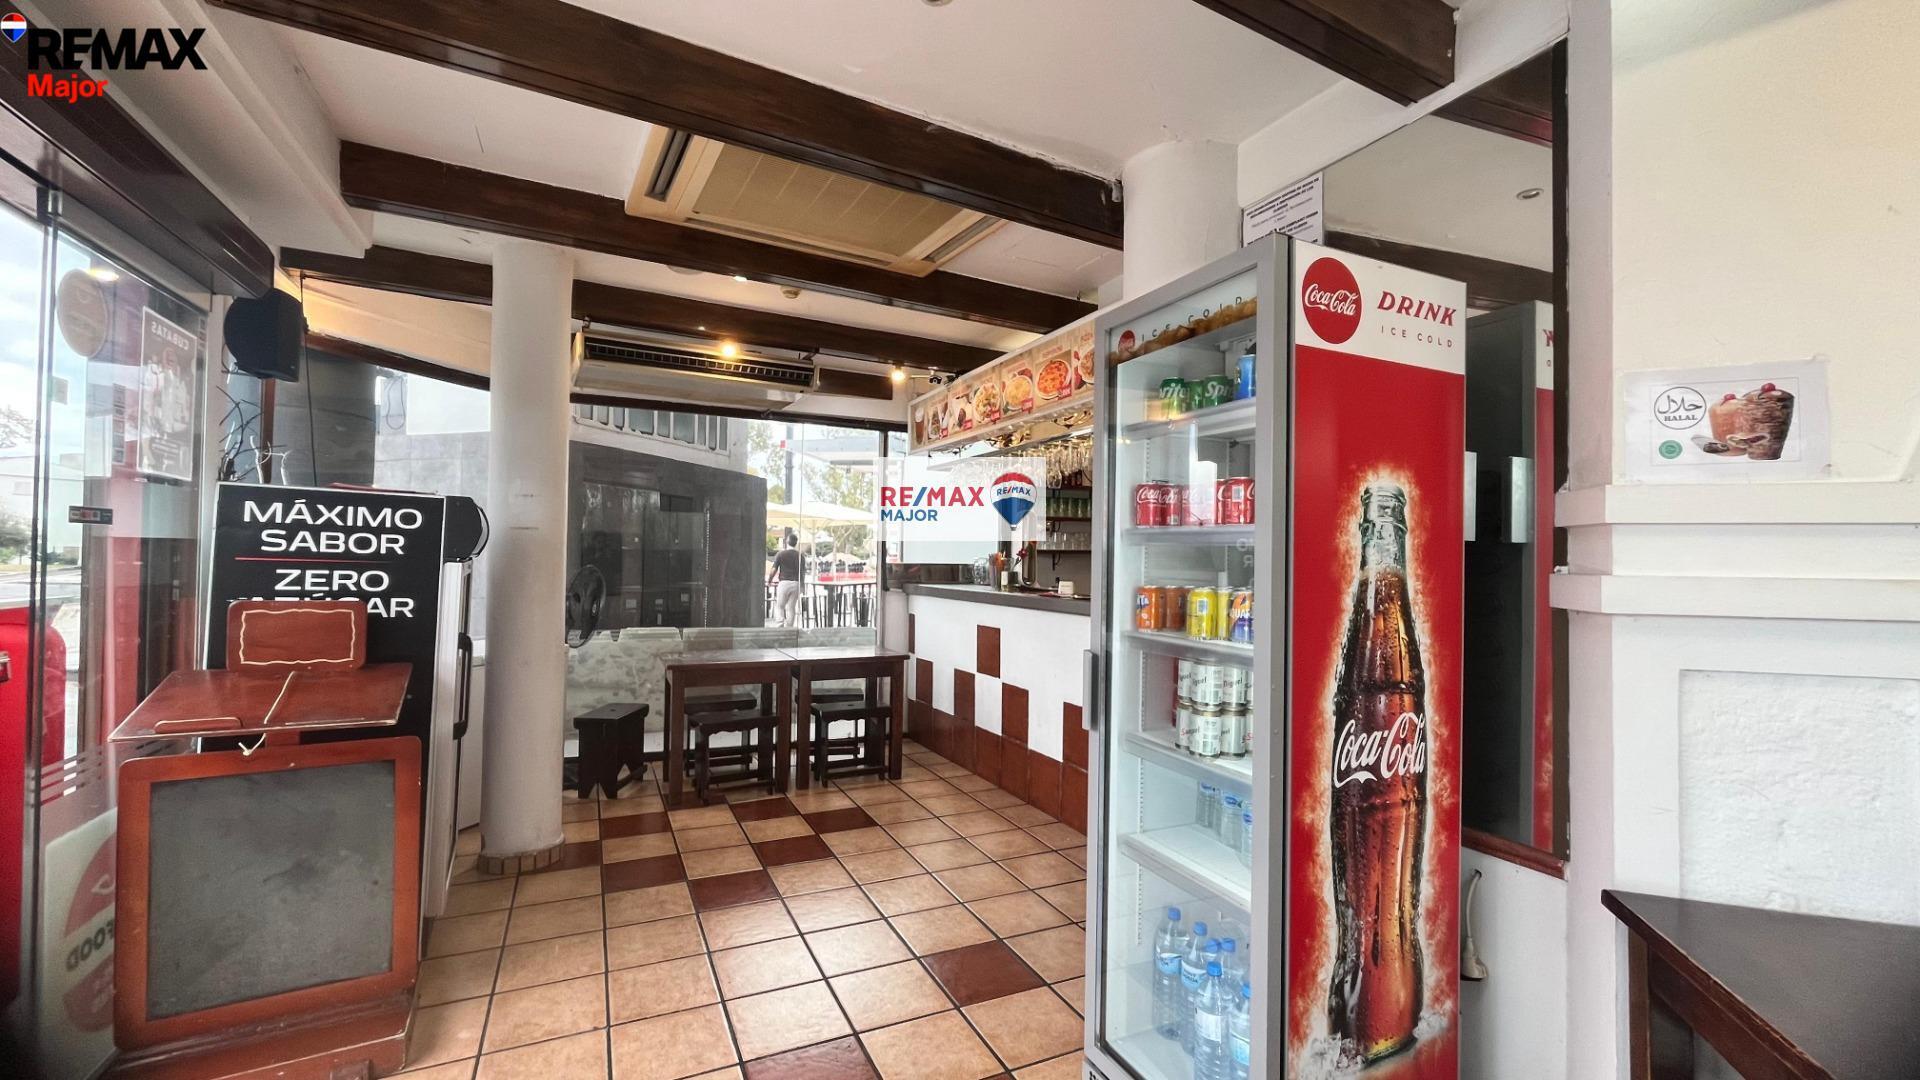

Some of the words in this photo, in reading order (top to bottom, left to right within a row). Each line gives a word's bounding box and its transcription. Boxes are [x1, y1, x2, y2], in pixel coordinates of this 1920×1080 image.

[1304, 282, 1360, 316] Coca-Cola
[1377, 290, 1457, 327] DRINK
[1381, 325, 1407, 338] ICE
[1417, 332, 1453, 348] COLD
[1657, 394, 1703, 414] حلال
[1664, 414, 1698, 422] HALAL
[243, 499, 423, 530] MÁXIMO
[260, 529, 405, 555] SABOR
[274, 568, 390, 592] ZERO
[1333, 712, 1426, 788] Coca-Cola
